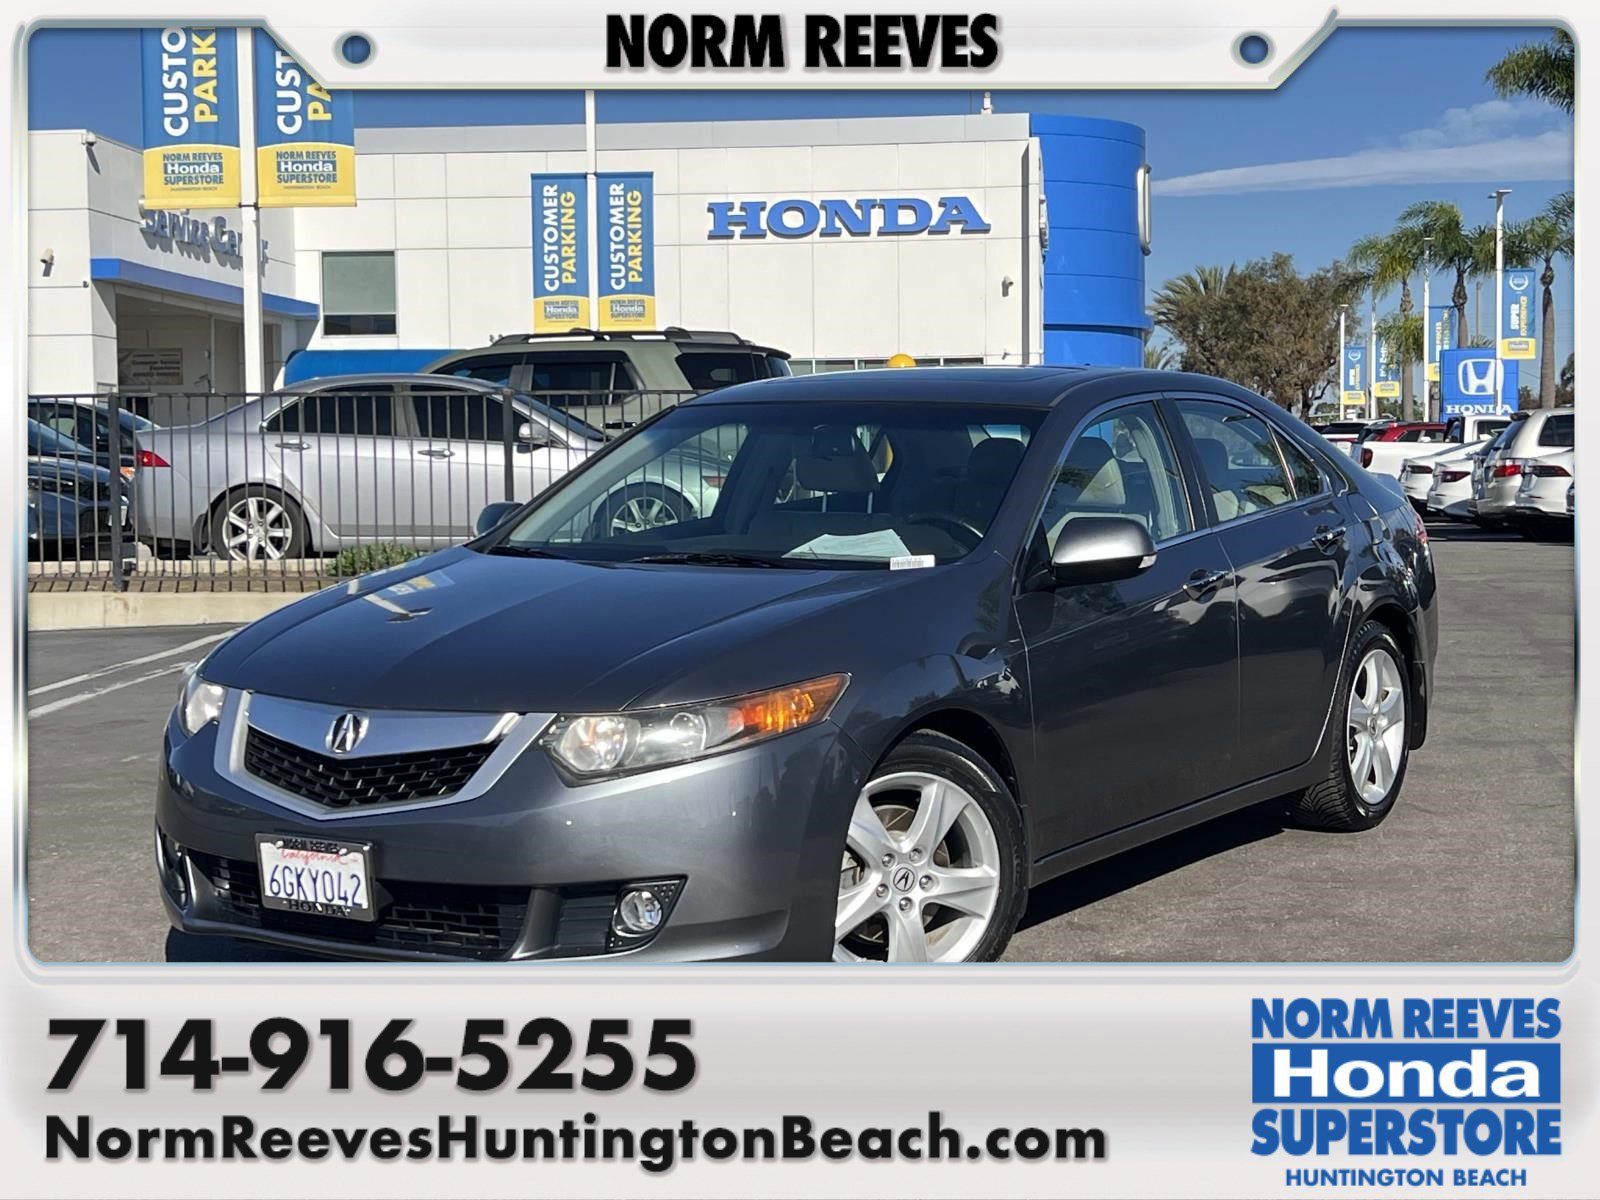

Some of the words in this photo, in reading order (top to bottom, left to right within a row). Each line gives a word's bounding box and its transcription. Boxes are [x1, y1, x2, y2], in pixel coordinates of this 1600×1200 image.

[161, 27, 190, 137] CUSTO
[191, 27, 218, 123] PARK
[163, 152, 190, 161] NORM
[192, 152, 223, 161] REEVES
[167, 162, 220, 174] Honda
[276, 151, 304, 160] NORM
[305, 151, 337, 160] REEVES
[280, 160, 333, 172] Honda
[164, 175, 224, 185] SUPERSTORE
[277, 173, 337, 184] SUPERSTORE
[141, 207, 210, 247] Service
[543, 184, 560, 292] CUSTOMER
[560, 191, 577, 284] PARKING
[609, 183, 626, 291] CUSTOMER
[627, 190, 643, 283] PARKING
[707, 197, 991, 240] HONDA
[269, 864, 363, 907] 6GKY042
